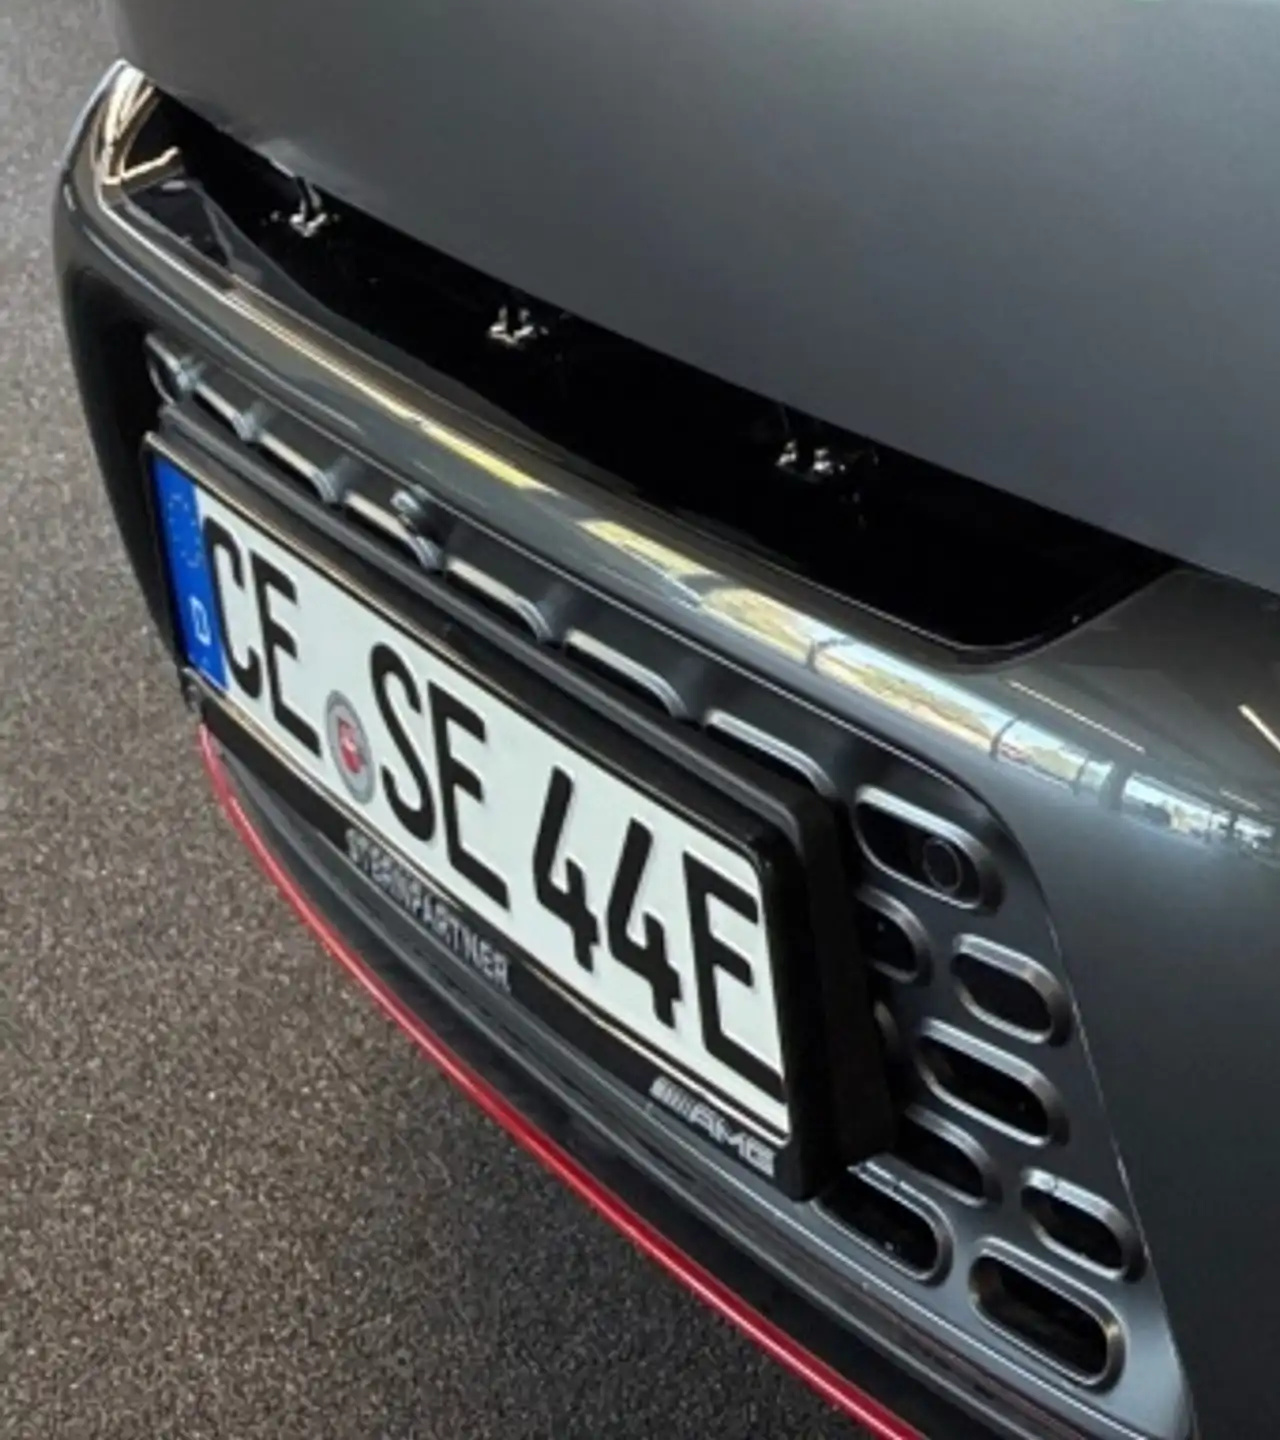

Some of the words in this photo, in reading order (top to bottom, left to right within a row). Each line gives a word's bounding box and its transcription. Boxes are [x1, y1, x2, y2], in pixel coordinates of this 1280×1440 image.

[202, 515, 323, 760] CE
[371, 642, 511, 909] SE
[533, 766, 788, 1106] 44E
